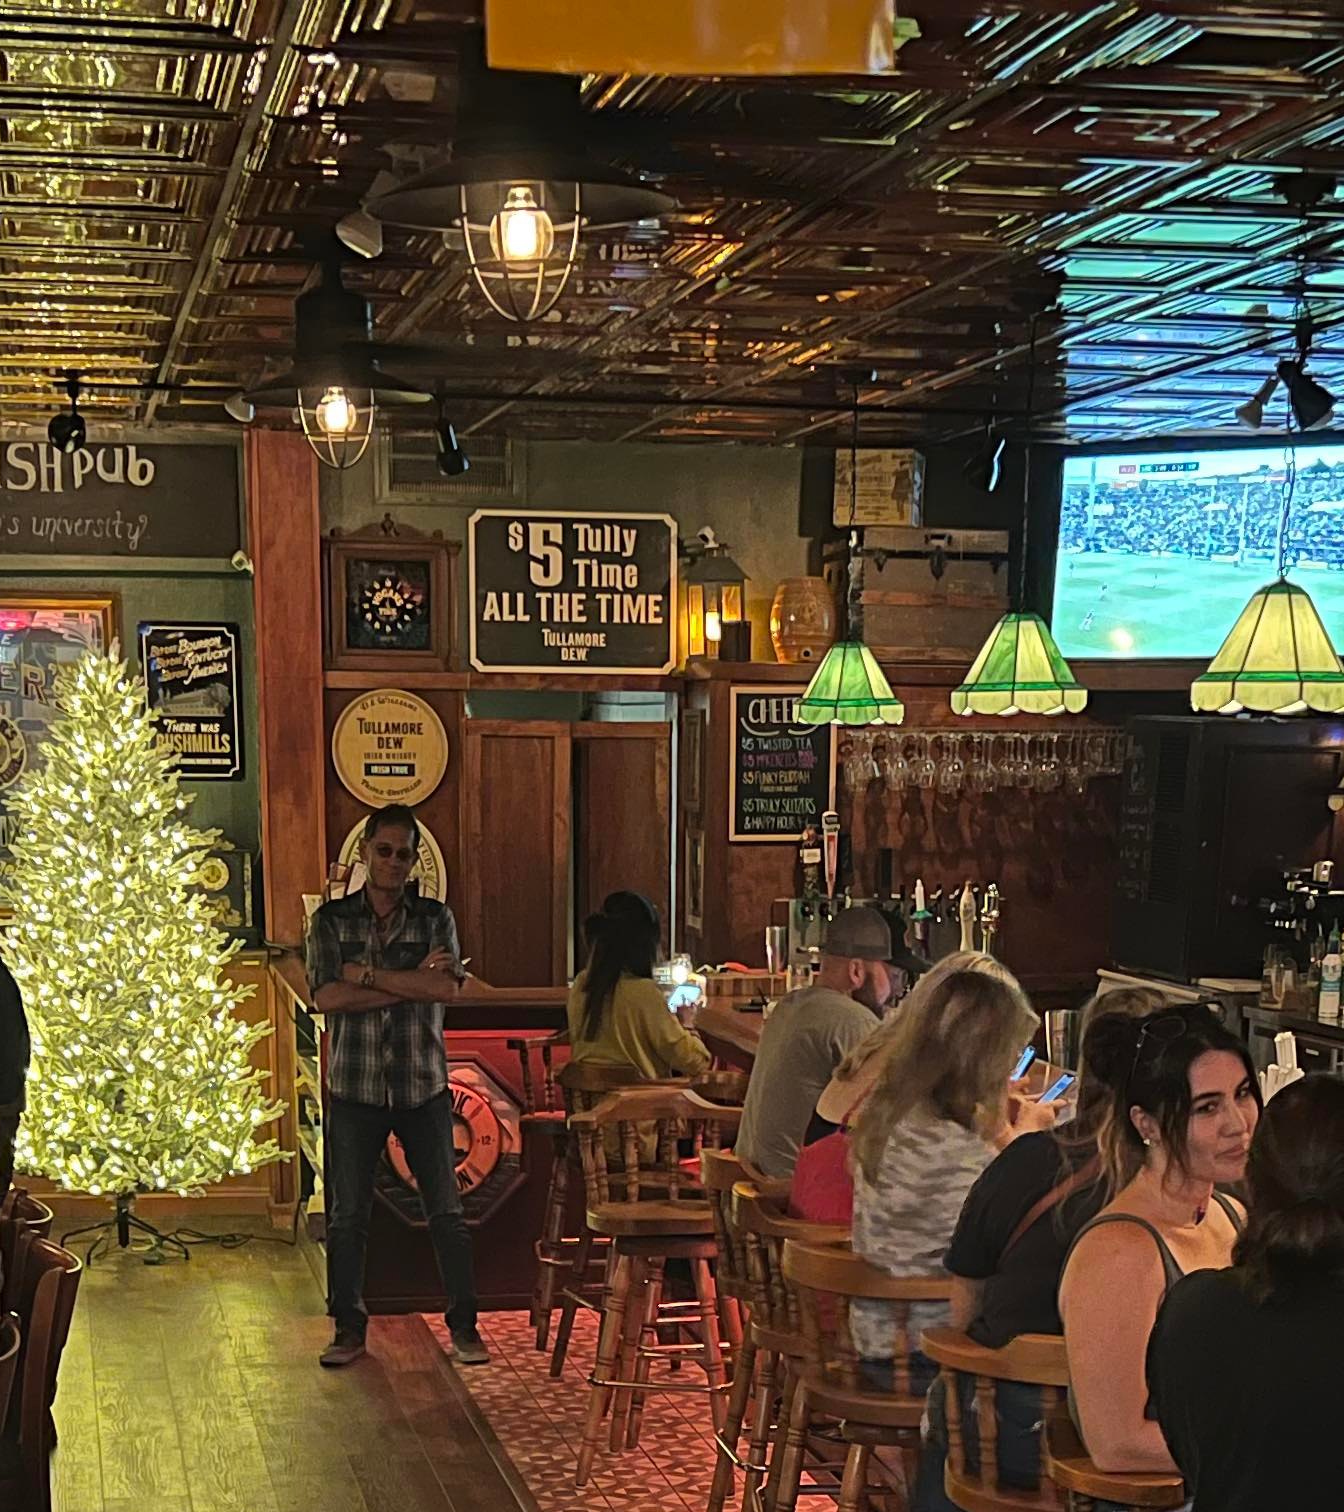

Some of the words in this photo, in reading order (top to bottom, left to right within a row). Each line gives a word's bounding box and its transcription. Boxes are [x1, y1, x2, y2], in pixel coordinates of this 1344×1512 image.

[572, 523, 637, 557] Tully
[572, 559, 638, 592] Time
[482, 592, 531, 622] ALL
[535, 592, 587, 623] THE
[595, 593, 664, 624] TIME
[541, 628, 606, 648] TULLAMORE
[748, 697, 799, 724] CHEE
[356, 717, 424, 735] TULLAMORE
